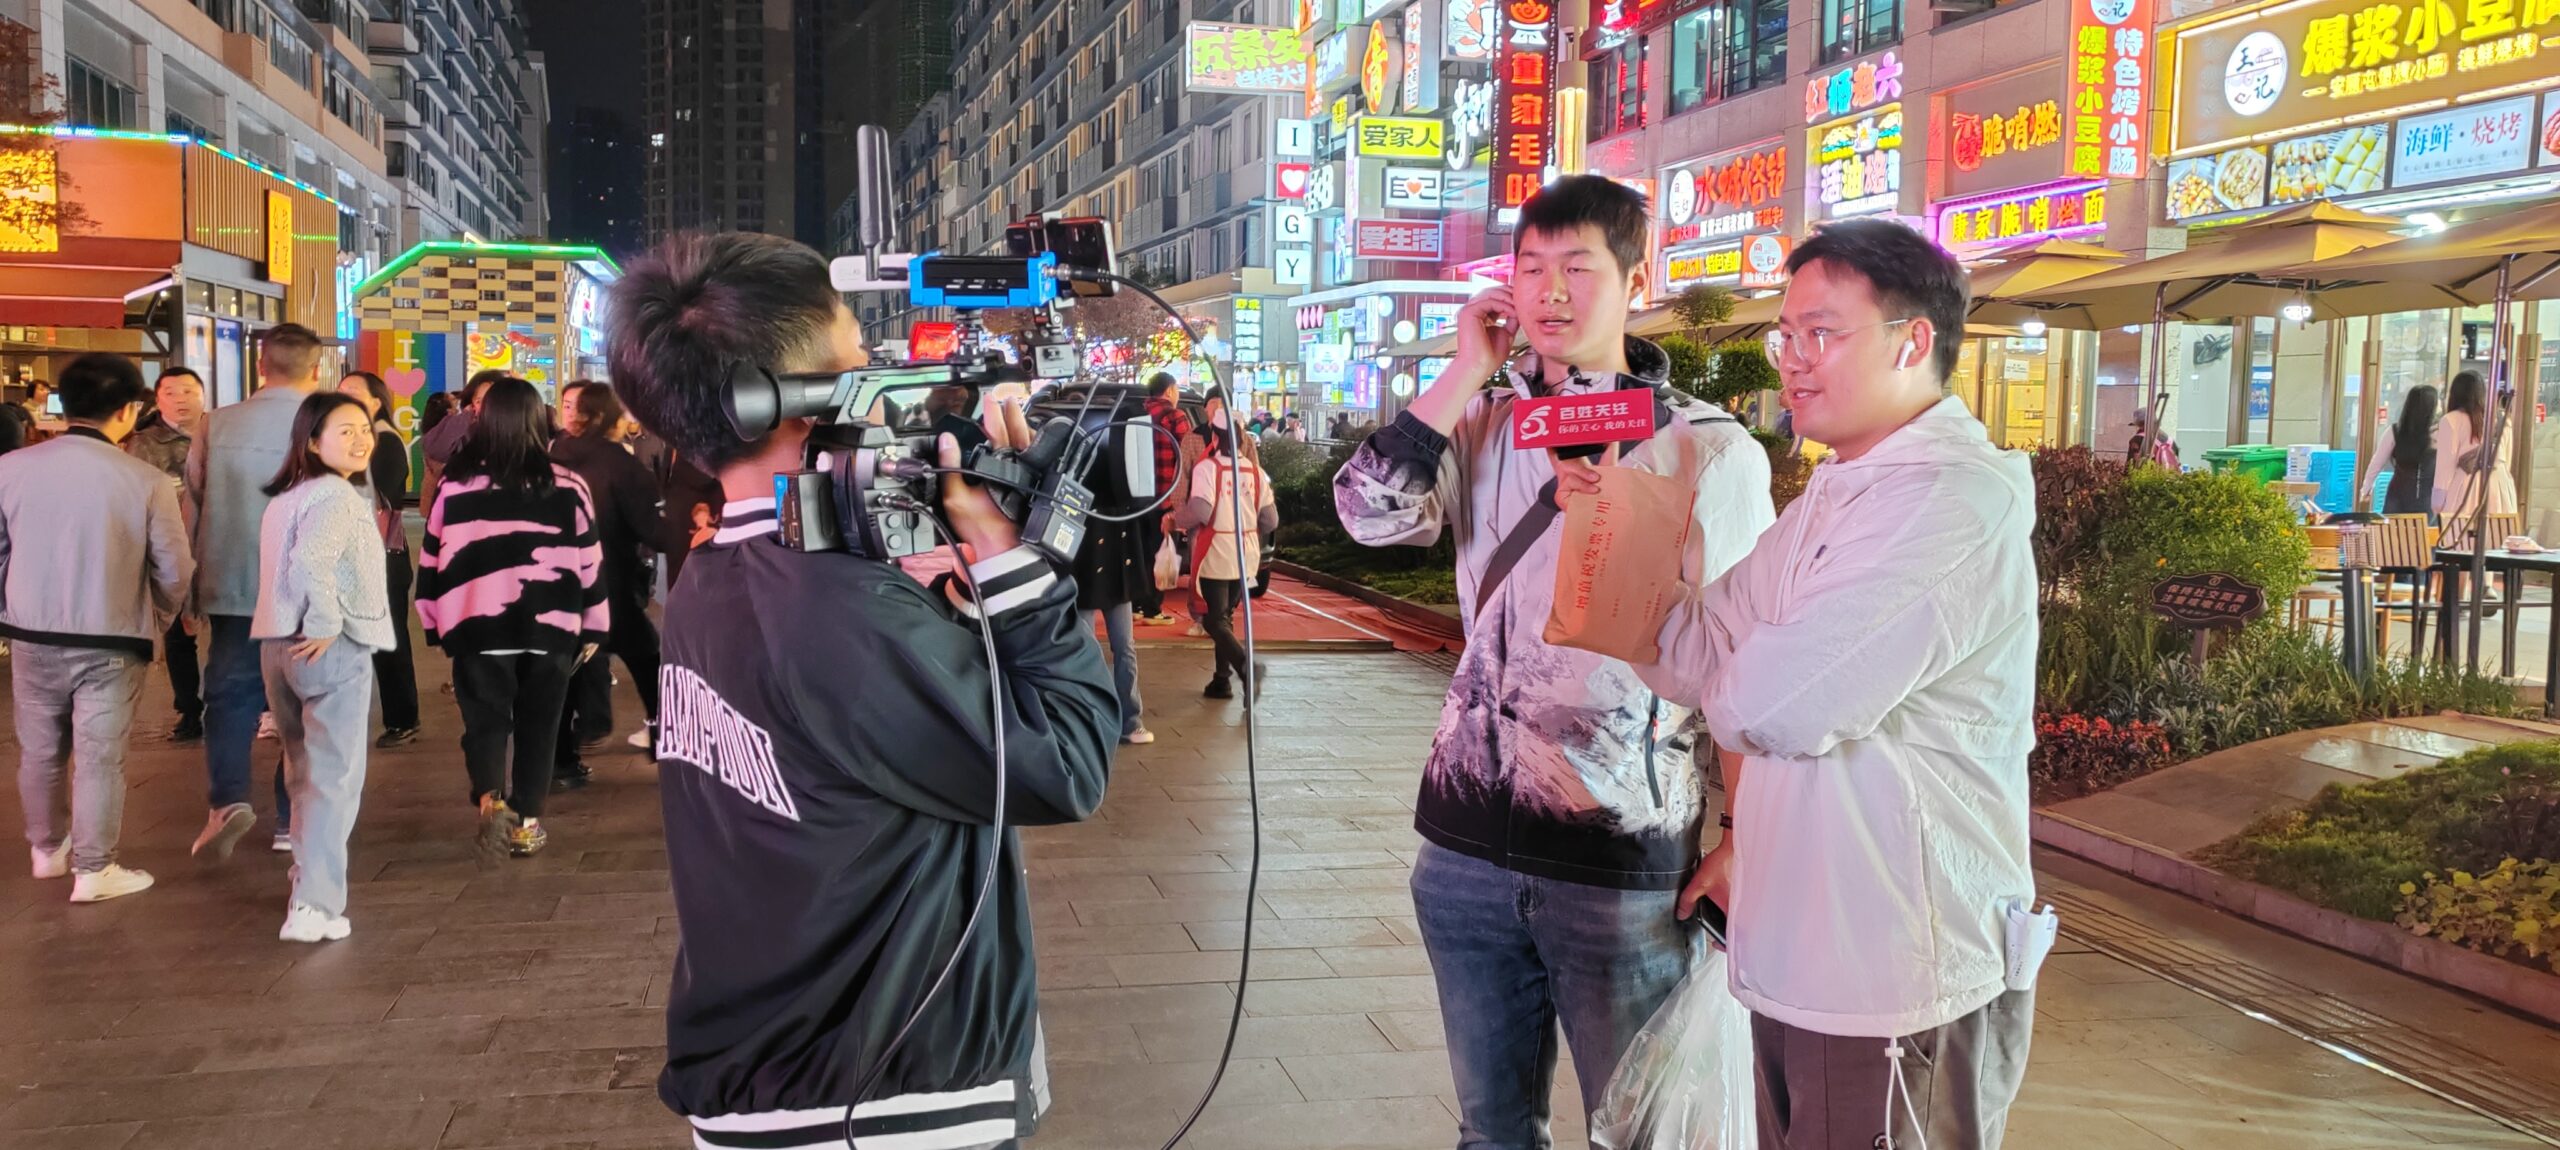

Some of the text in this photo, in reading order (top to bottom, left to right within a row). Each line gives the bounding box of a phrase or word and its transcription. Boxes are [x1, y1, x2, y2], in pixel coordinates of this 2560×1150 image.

[2073, 26, 2107, 174] 爆浆小豆腐
[2108, 28, 2143, 175] 特色烤小肠
[1290, 127, 1299, 147] I
[1363, 125, 1440, 148] 爱家人
[1980, 100, 2062, 158] 脆哨燃
[1390, 176, 1438, 200] 自己
[1284, 215, 1299, 234] G
[1360, 226, 1441, 252] 爱生活
[1285, 258, 1299, 277] Y
[394, 339, 420, 363] I
[393, 406, 422, 431] G
[1576, 501, 1611, 610] 增值税发票专用
[656, 664, 800, 822] AMPION
